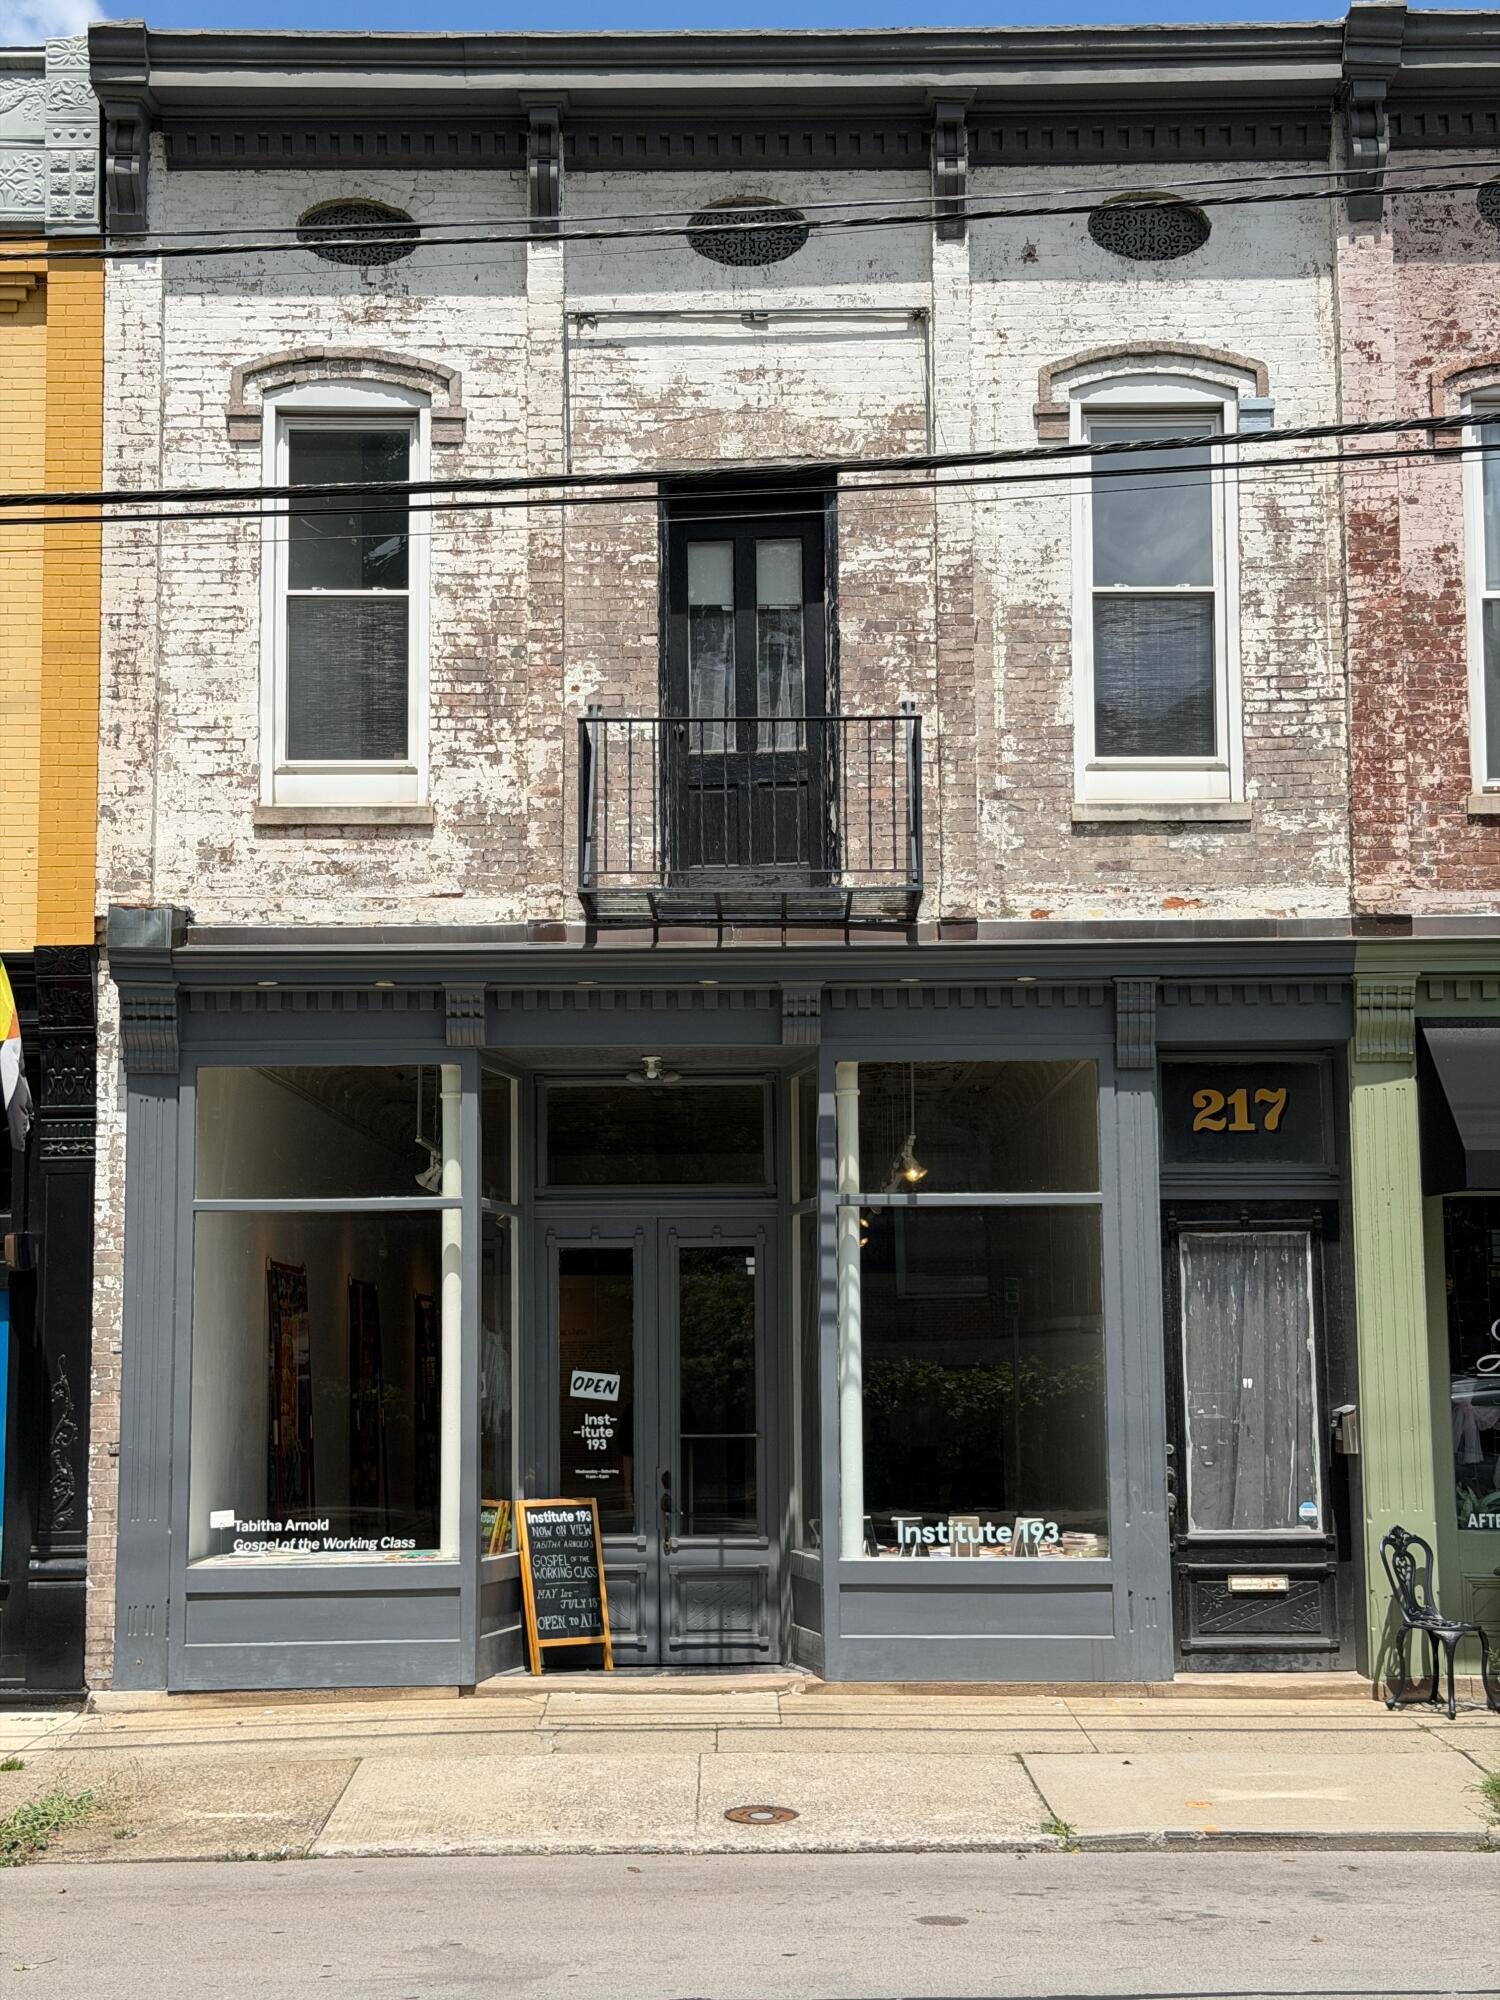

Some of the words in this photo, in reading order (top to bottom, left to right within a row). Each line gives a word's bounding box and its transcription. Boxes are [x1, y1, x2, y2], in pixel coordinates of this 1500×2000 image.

[1192, 1088, 1287, 1132] 217
[572, 1376, 618, 1395] OPEN
[586, 1439, 607, 1451] 193
[527, 1510, 574, 1524] Institute
[575, 1510, 592, 1522] 193
[234, 1519, 282, 1532] Tabitha
[285, 1519, 329, 1532] Arnold
[531, 1525, 553, 1538] NOW
[555, 1525, 567, 1537] ON
[570, 1523, 592, 1537] VIEW
[897, 1520, 1013, 1544] Institute
[1019, 1521, 1060, 1544] 193
[233, 1538, 279, 1551] Gospel
[281, 1538, 297, 1550] of
[298, 1538, 320, 1550] the
[323, 1537, 378, 1551] Working
[382, 1536, 416, 1549] Class
[532, 1554, 570, 1567] GOSPEL
[533, 1566, 573, 1579] WORKING
[573, 1566, 597, 1579] CLASS
[537, 1588, 558, 1599] MAY
[560, 1598, 587, 1609] JULY
[537, 1614, 567, 1630] OPEN
[569, 1617, 579, 1626] TO
[580, 1612, 600, 1628] ALL
